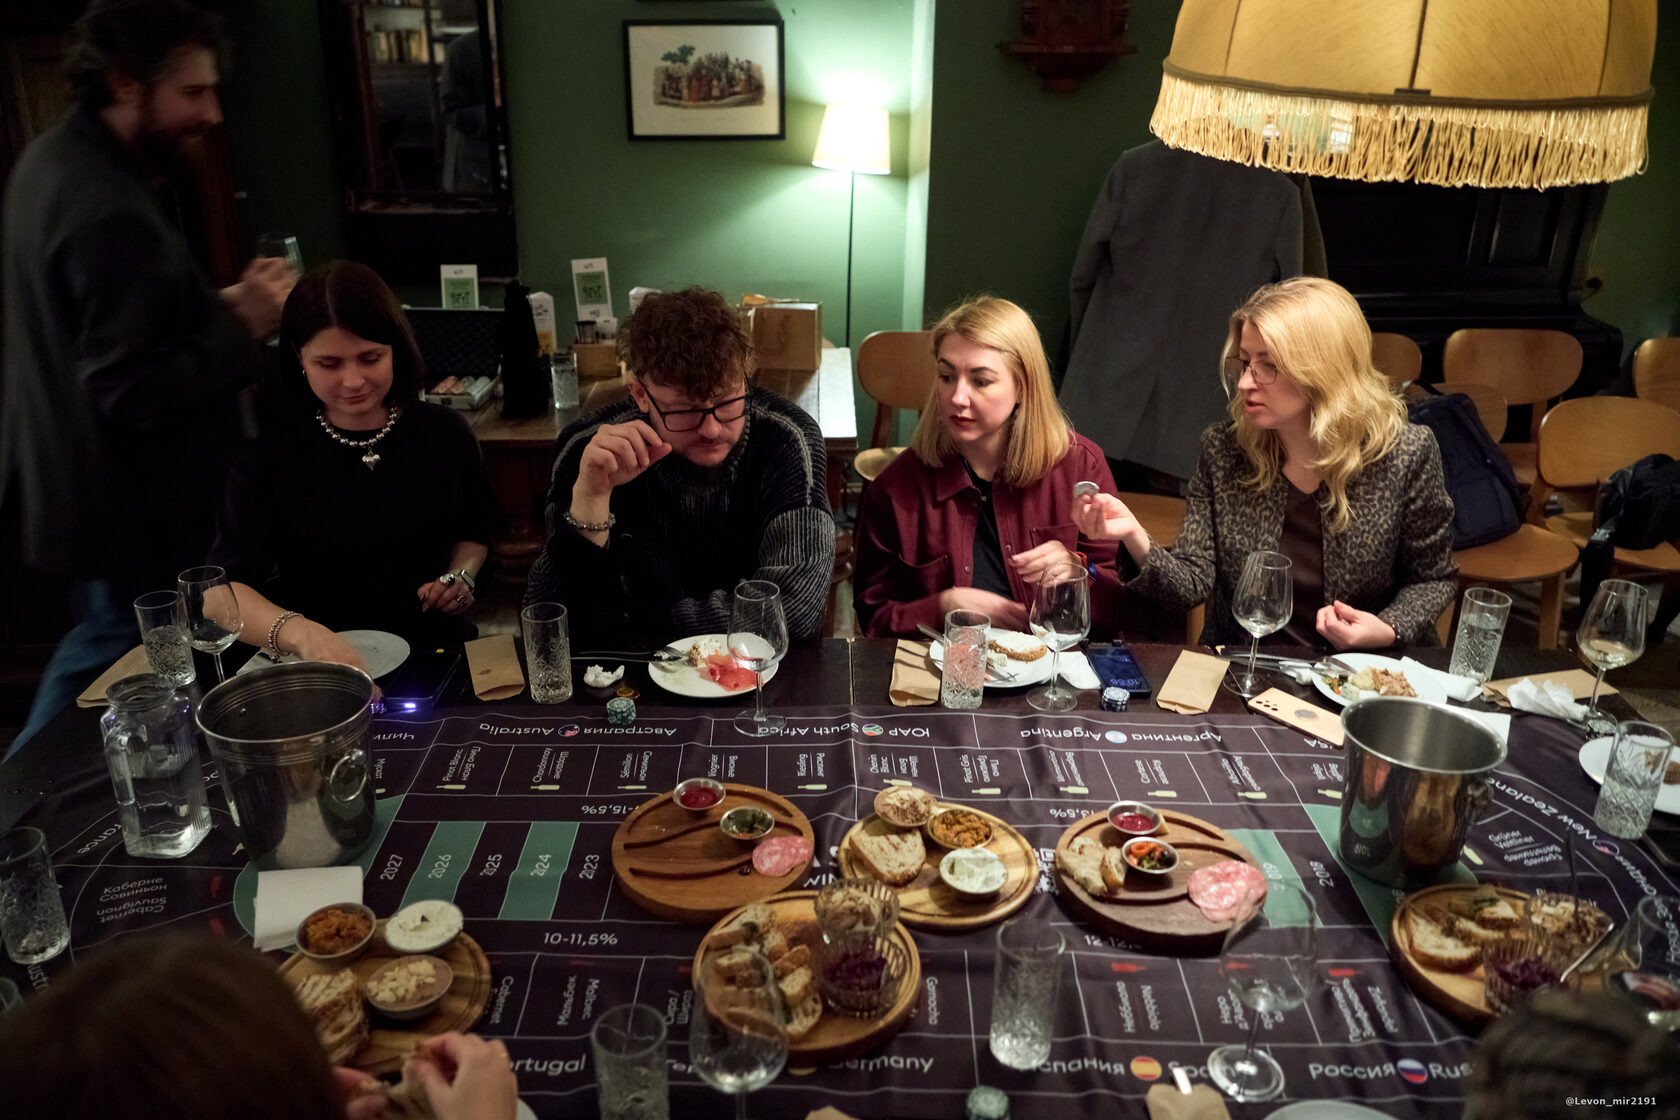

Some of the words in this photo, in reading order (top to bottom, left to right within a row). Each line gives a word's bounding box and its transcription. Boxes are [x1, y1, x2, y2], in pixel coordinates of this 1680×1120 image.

[479, 723, 555, 736] Australia
[583, 726, 677, 737] Австралия
[758, 726, 809, 736] Africa
[813, 722, 859, 736] South
[889, 727, 930, 738] ЮАР
[1020, 726, 1101, 741] Argentina
[1131, 730, 1222, 742] Аргентина
[533, 748, 553, 783] Chardonnay
[554, 751, 570, 780] Шардоне
[708, 754, 719, 777] Viognier
[797, 753, 808, 777] Riesling
[816, 752, 825, 777] Рислинг
[77, 823, 122, 853] rance
[1557, 815, 1597, 840] New
[380, 854, 403, 881] 2027
[428, 853, 452, 879] 2026
[1310, 860, 1334, 887] 2018
[100, 885, 167, 902] Совиньон
[104, 877, 163, 894] Каберне
[97, 896, 167, 916] Sauvignon
[101, 905, 164, 923] Cabernet
[543, 932, 618, 947] 10-11,5%
[490, 976, 514, 1024] Cabernet
[556, 974, 578, 1026] Мальбек
[582, 978, 600, 1020] Malbec
[1116, 980, 1136, 1033] Неббиоло
[1140, 985, 1160, 1032] Nebbiolo
[1308, 1063, 1395, 1080] Россия
